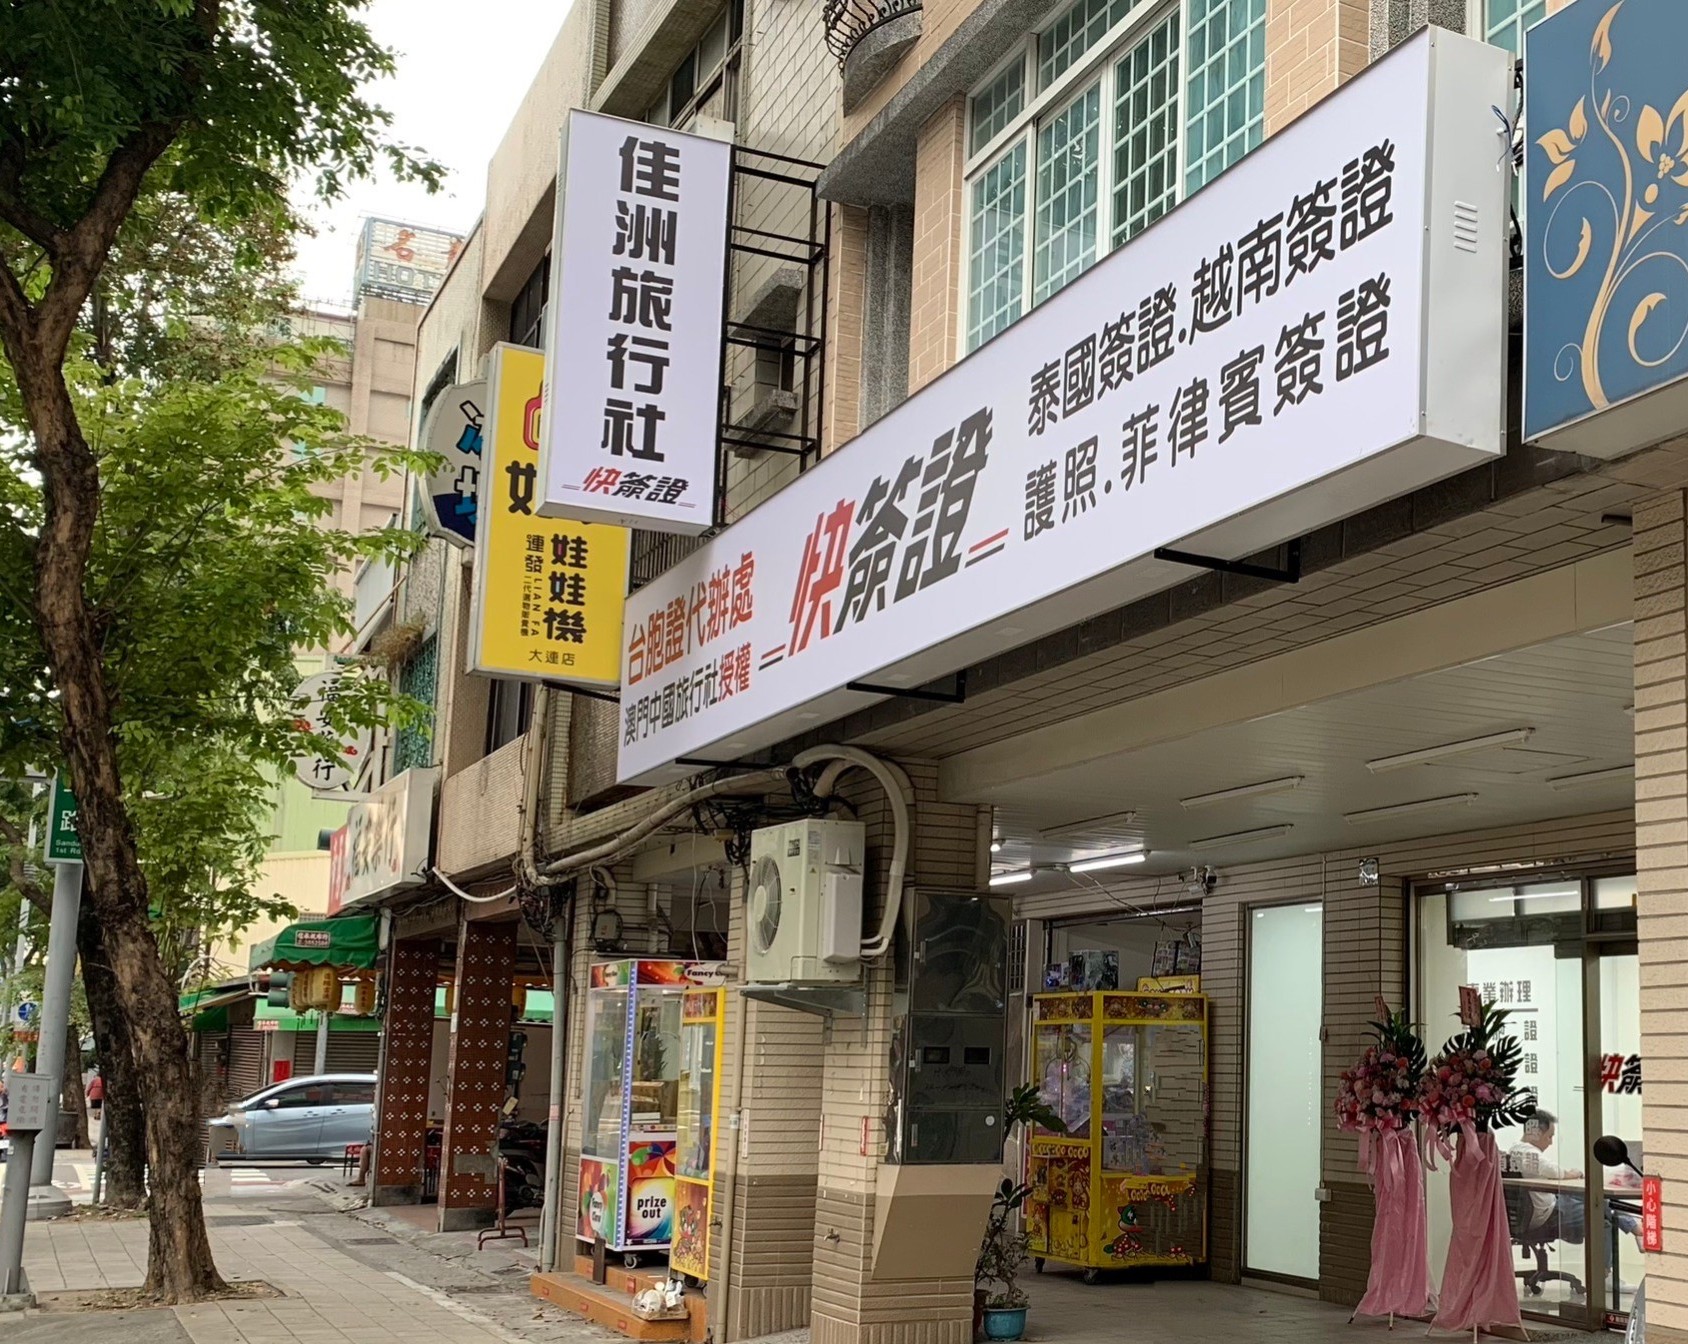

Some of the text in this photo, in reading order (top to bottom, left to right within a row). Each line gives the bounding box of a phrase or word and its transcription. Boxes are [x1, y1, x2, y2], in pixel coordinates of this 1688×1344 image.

[601, 136, 680, 462] 佳洲旅行社
[583, 466, 688, 505] 快簽證
[525, 534, 545, 573] 連發
[788, 406, 993, 657] 快簽證
[531, 577, 543, 636] LIAN FA
[543, 533, 588, 644] 娃娃機
[628, 551, 754, 685] 台胞證代辦處
[529, 649, 575, 666] 大連店
[624, 642, 751, 745] 澳門中國旅行社授權
[687, 969, 713, 978] Fancy
[637, 1196, 666, 1210] prize
[642, 1208, 661, 1218] out
[1646, 1181, 1658, 1246] 小心階梯
